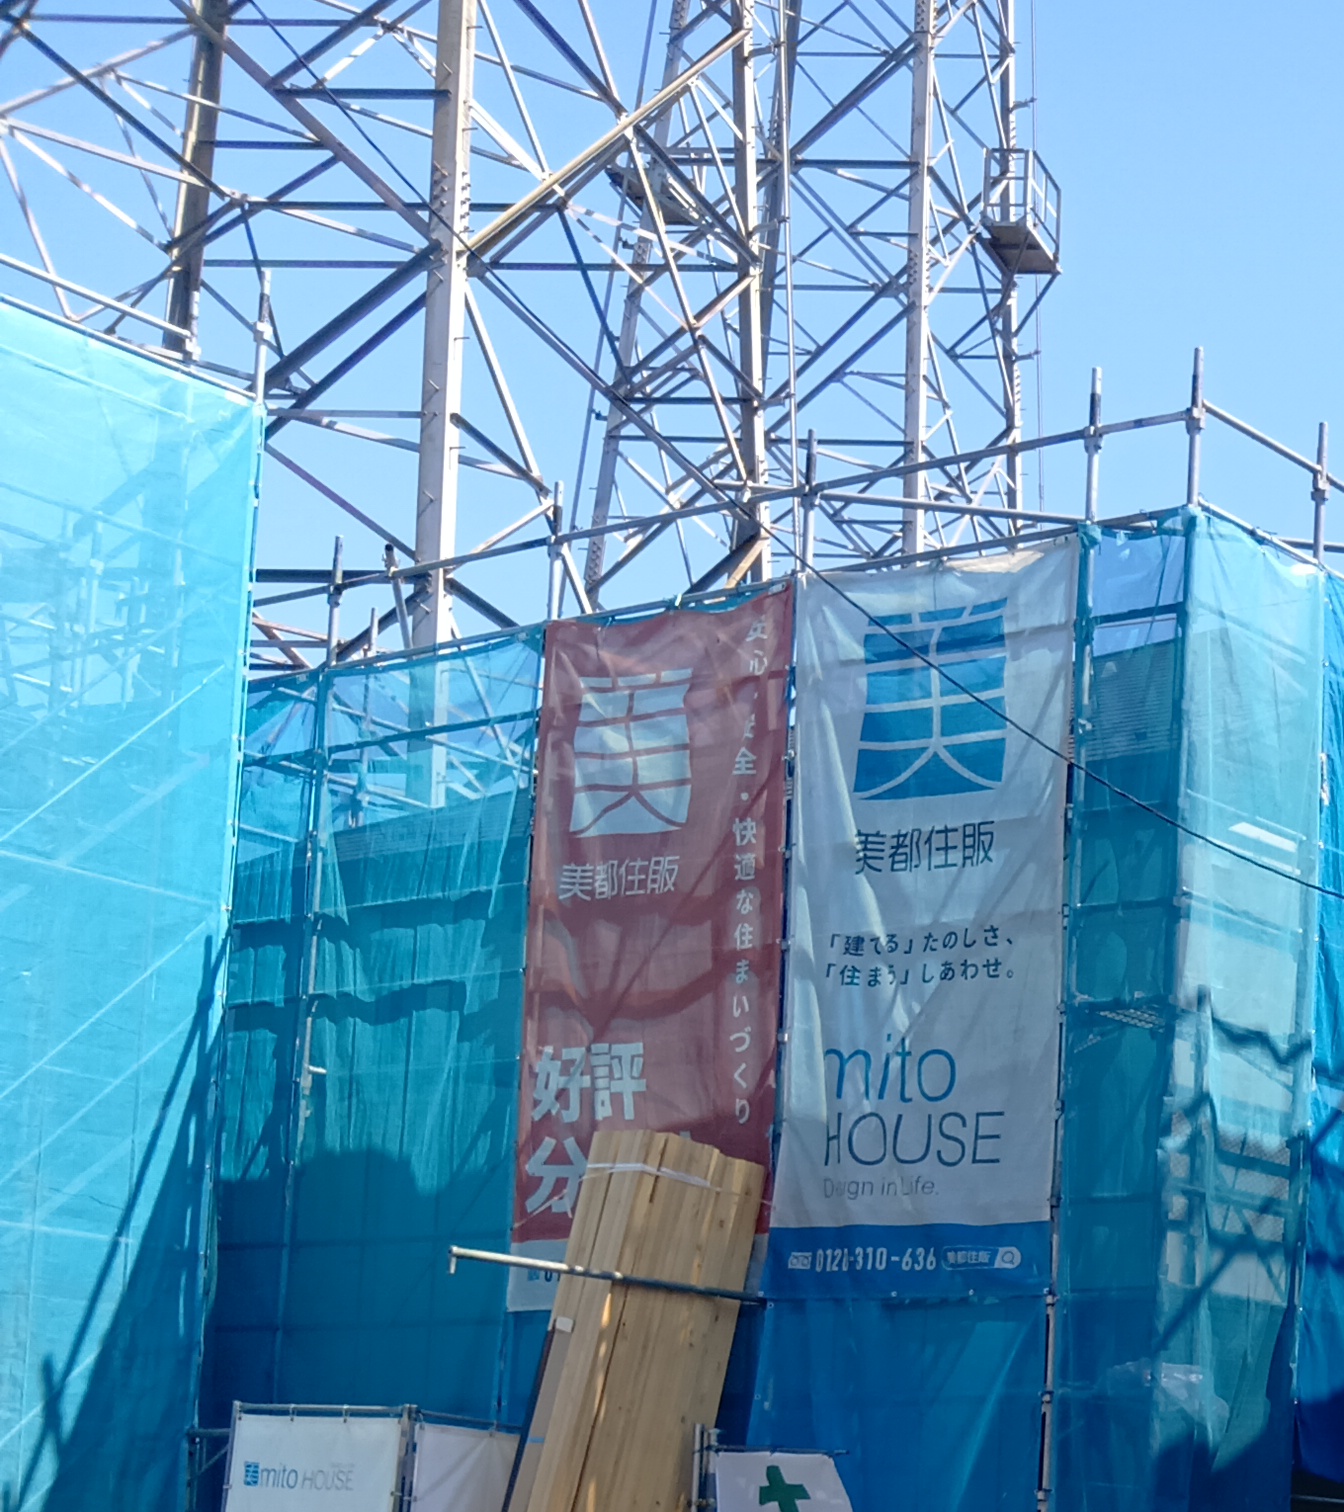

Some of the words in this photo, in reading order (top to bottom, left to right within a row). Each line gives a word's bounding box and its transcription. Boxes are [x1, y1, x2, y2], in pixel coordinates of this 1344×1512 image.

[854, 820, 995, 876] 美都住販
[558, 855, 680, 902] 美都住販
[829, 924, 1014, 957] 「建てる」たのしさ、
[531, 1041, 647, 1123] 好評
[823, 1033, 956, 1103] mito
[824, 1110, 1005, 1168] HOUSE
[261, 1463, 299, 1489] mito
[301, 1469, 354, 1491] HOUSE
